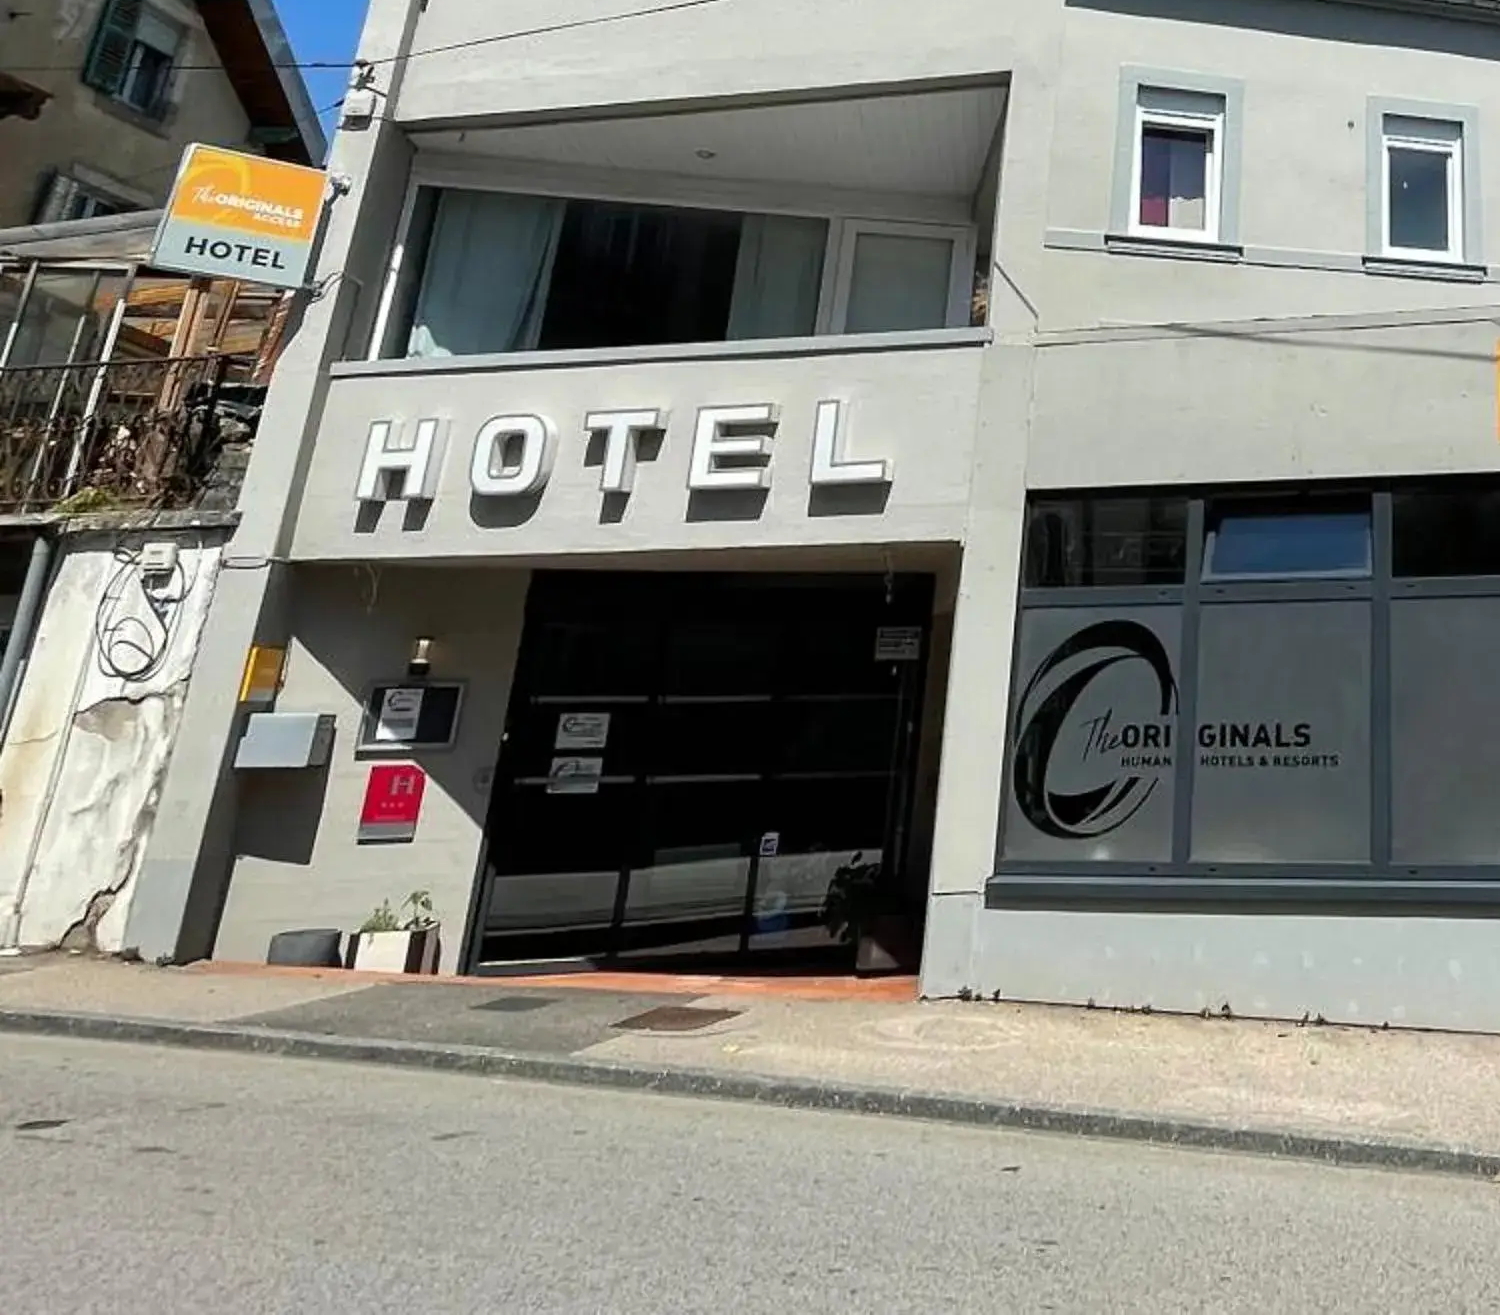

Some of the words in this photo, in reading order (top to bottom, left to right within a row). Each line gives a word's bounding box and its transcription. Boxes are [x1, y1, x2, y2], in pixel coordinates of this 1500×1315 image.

[215, 193, 304, 220] ORIGINALS
[184, 236, 286, 270] HOTEL
[355, 399, 894, 501] HOTEL
[1080, 707, 1122, 763] The
[1120, 755, 1173, 767] HUMAN
[1200, 754, 1255, 767] HOTELS
[1258, 754, 1269, 767] &
[1273, 754, 1340, 767] RESORTS
